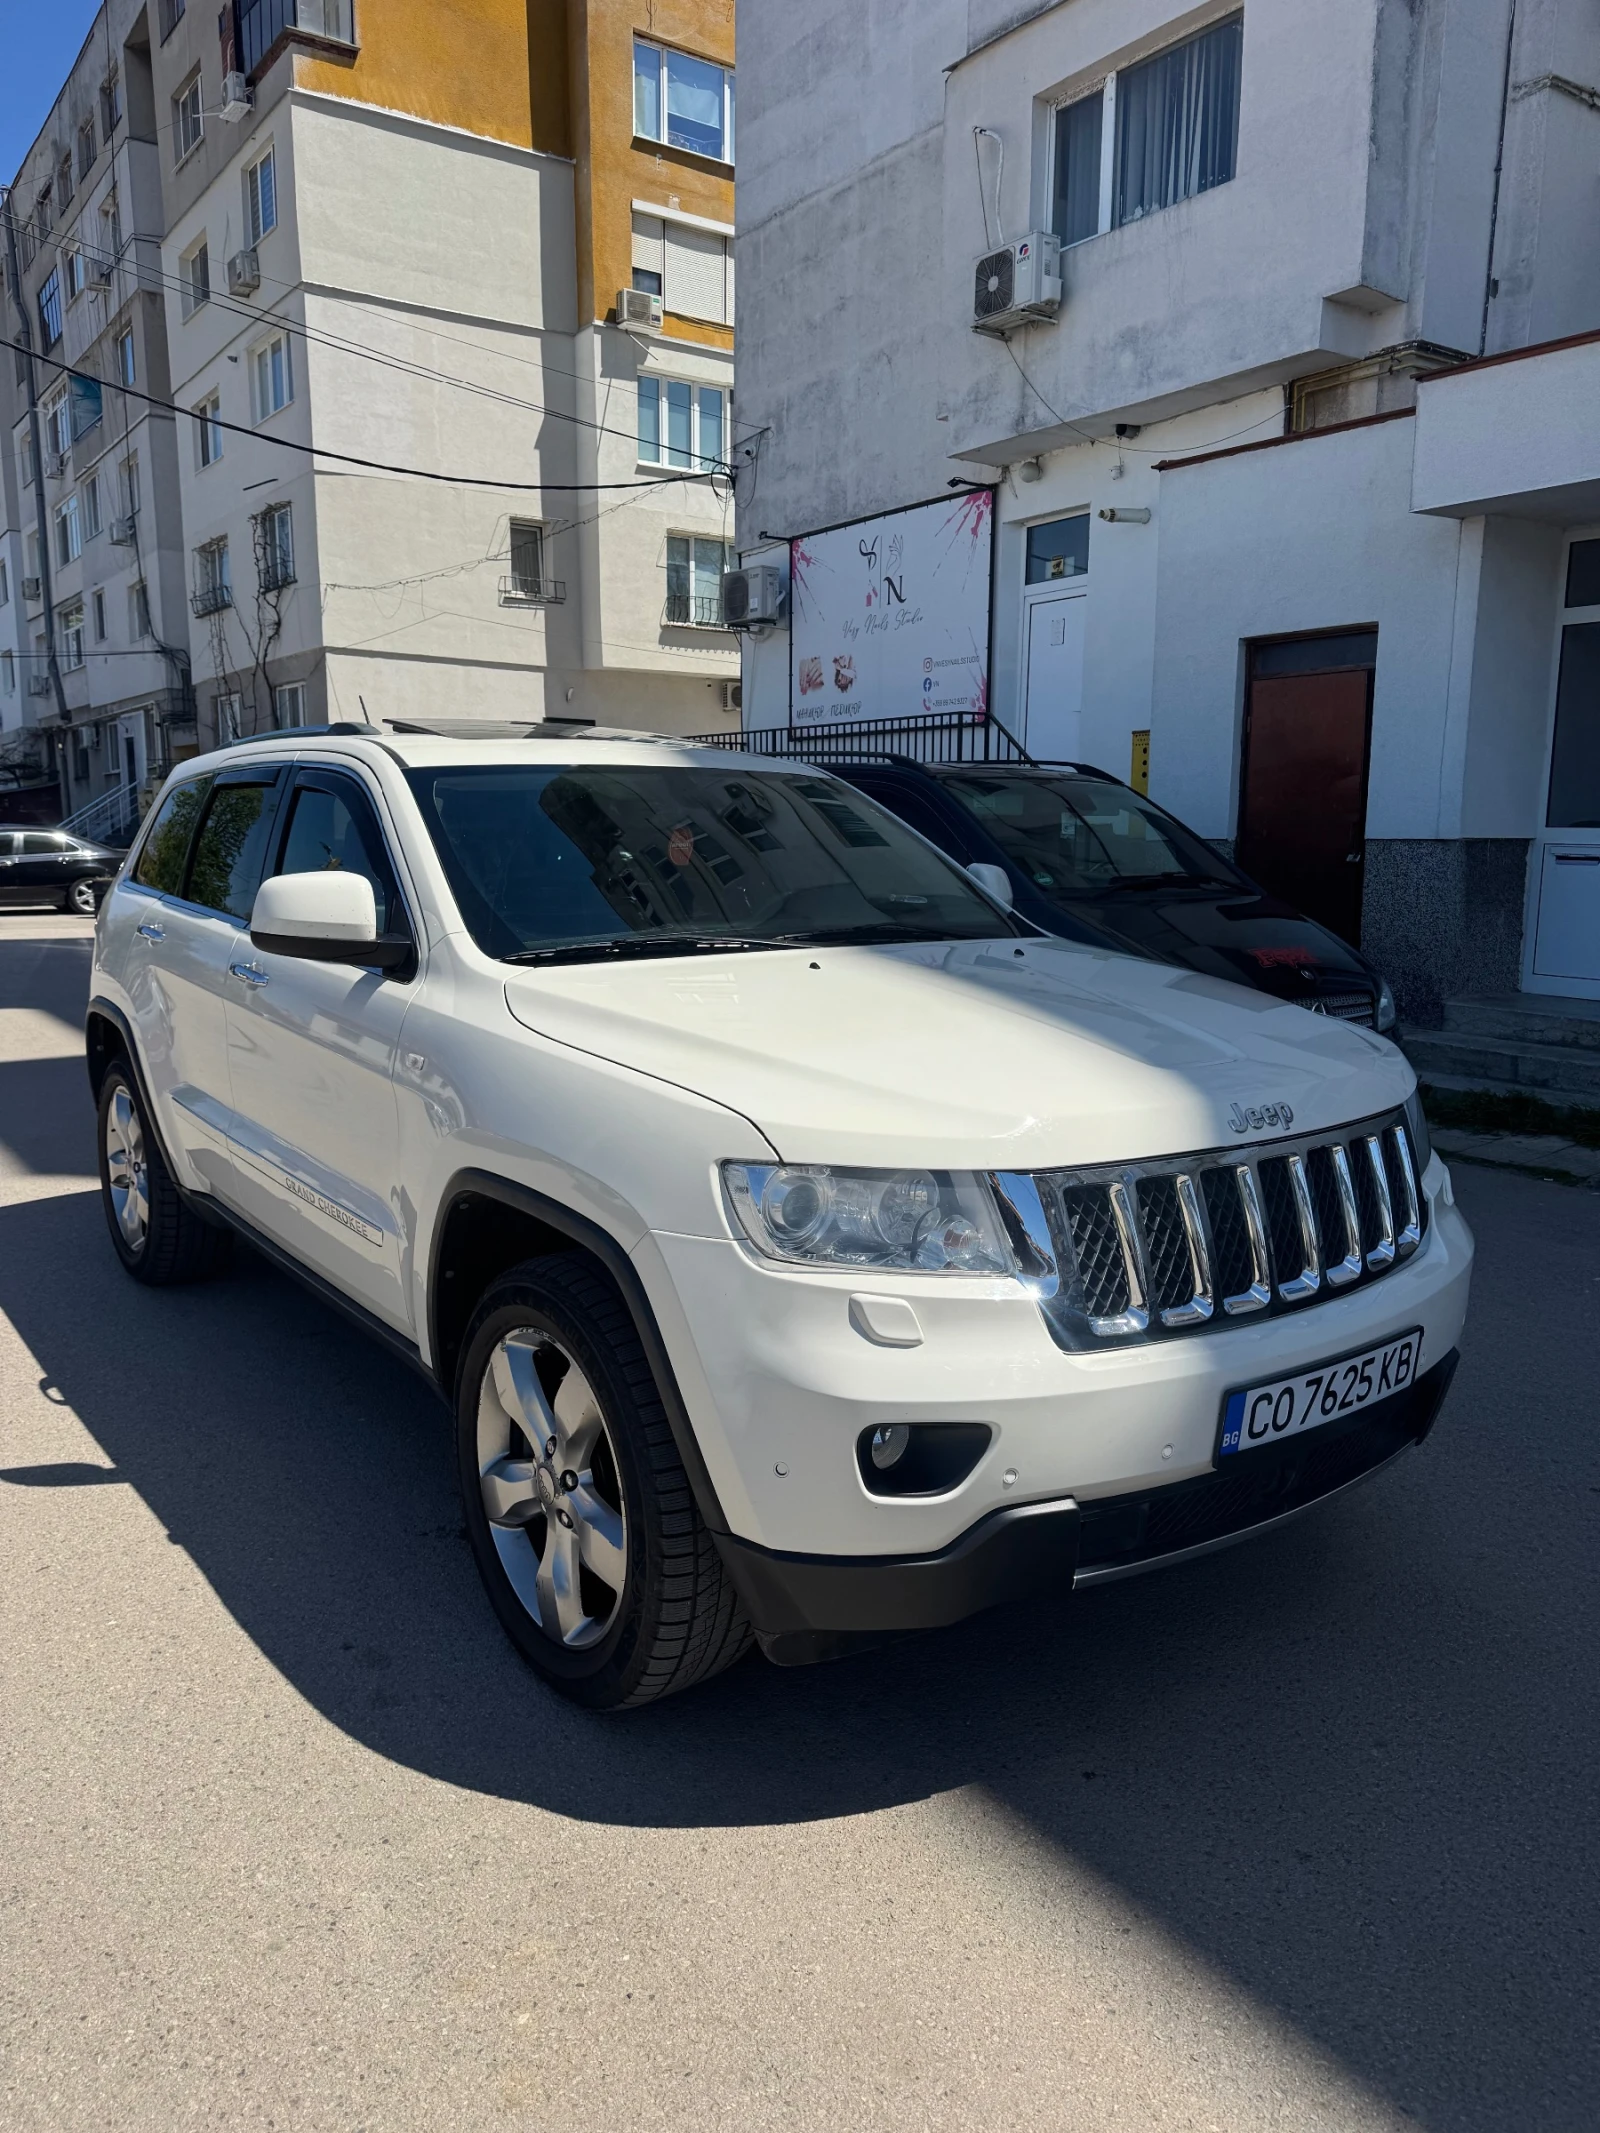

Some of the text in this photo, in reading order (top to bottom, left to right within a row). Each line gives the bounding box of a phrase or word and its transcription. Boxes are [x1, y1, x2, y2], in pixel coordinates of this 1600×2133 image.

[883, 575, 907, 606] N
[864, 613, 889, 635] Nails
[894, 607, 923, 631] Studio
[1227, 1100, 1294, 1134] Jeep
[285, 1176, 369, 1237] GRAND CHEROKEE
[1247, 1339, 1413, 1440] CO 7625 KB
[1222, 1430, 1240, 1447] BG
